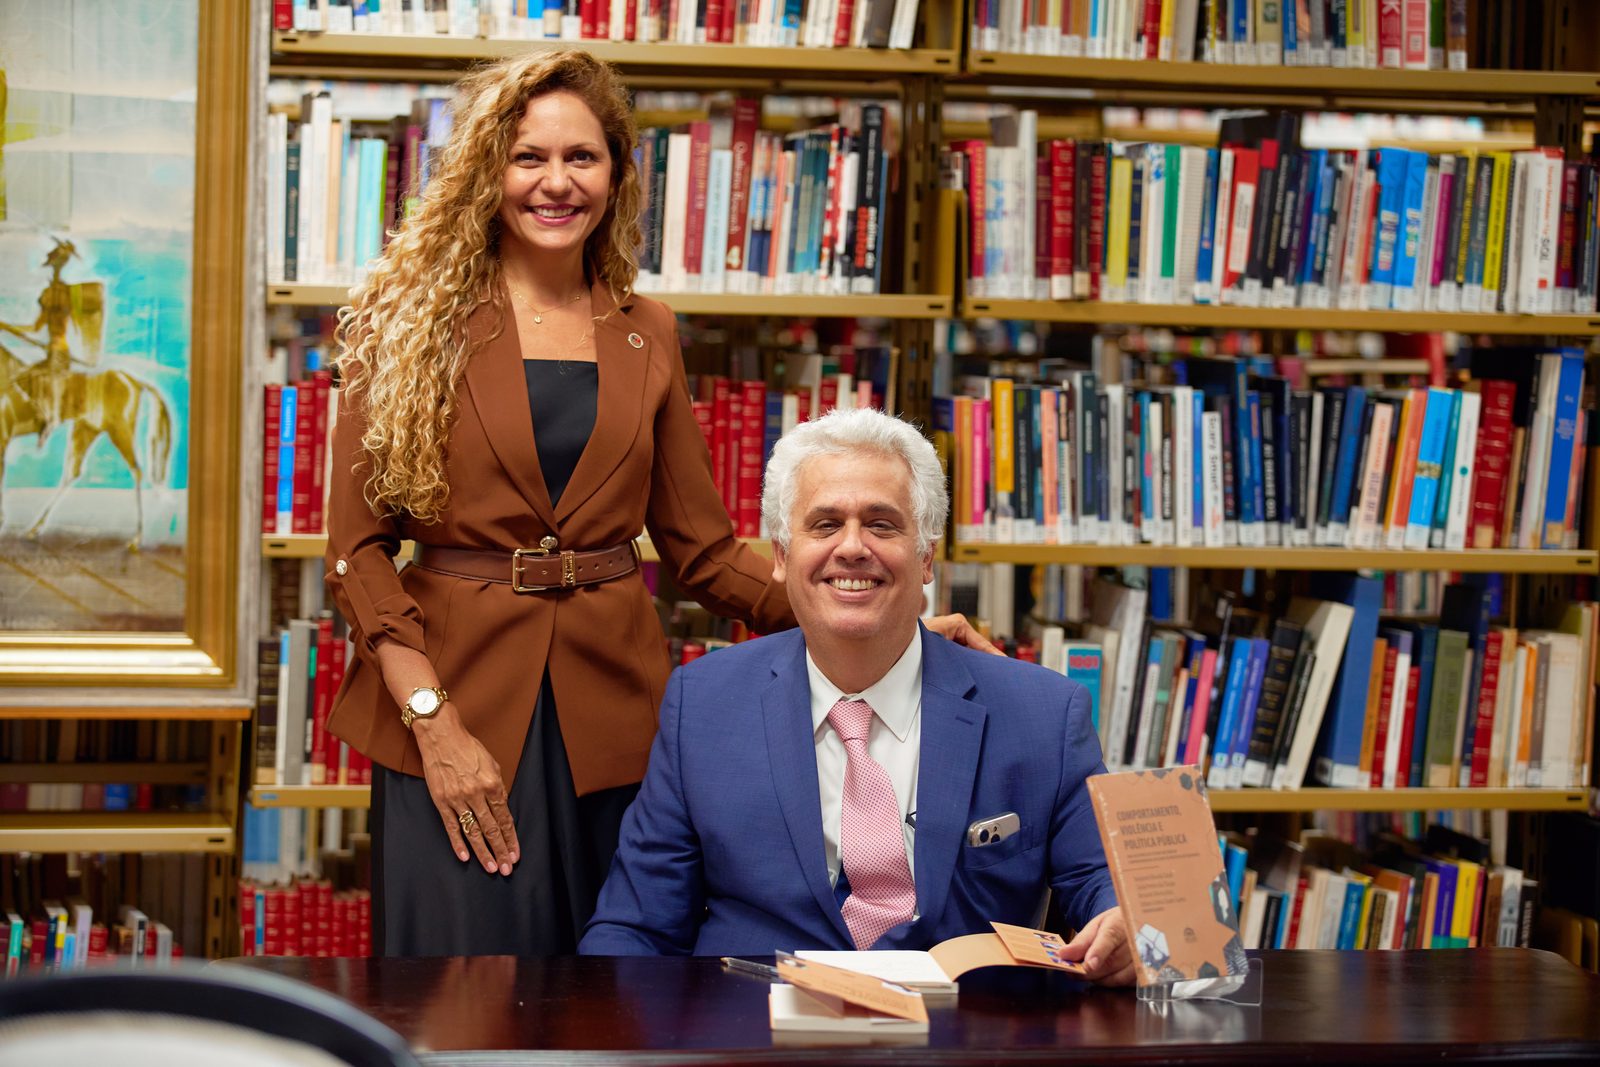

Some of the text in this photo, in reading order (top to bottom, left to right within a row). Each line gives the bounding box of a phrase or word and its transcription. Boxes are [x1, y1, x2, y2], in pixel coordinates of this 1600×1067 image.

[1120, 821, 1158, 836] VIOLÊNCIA
[1123, 833, 1188, 850] POLÍTICA PÚBLICA
